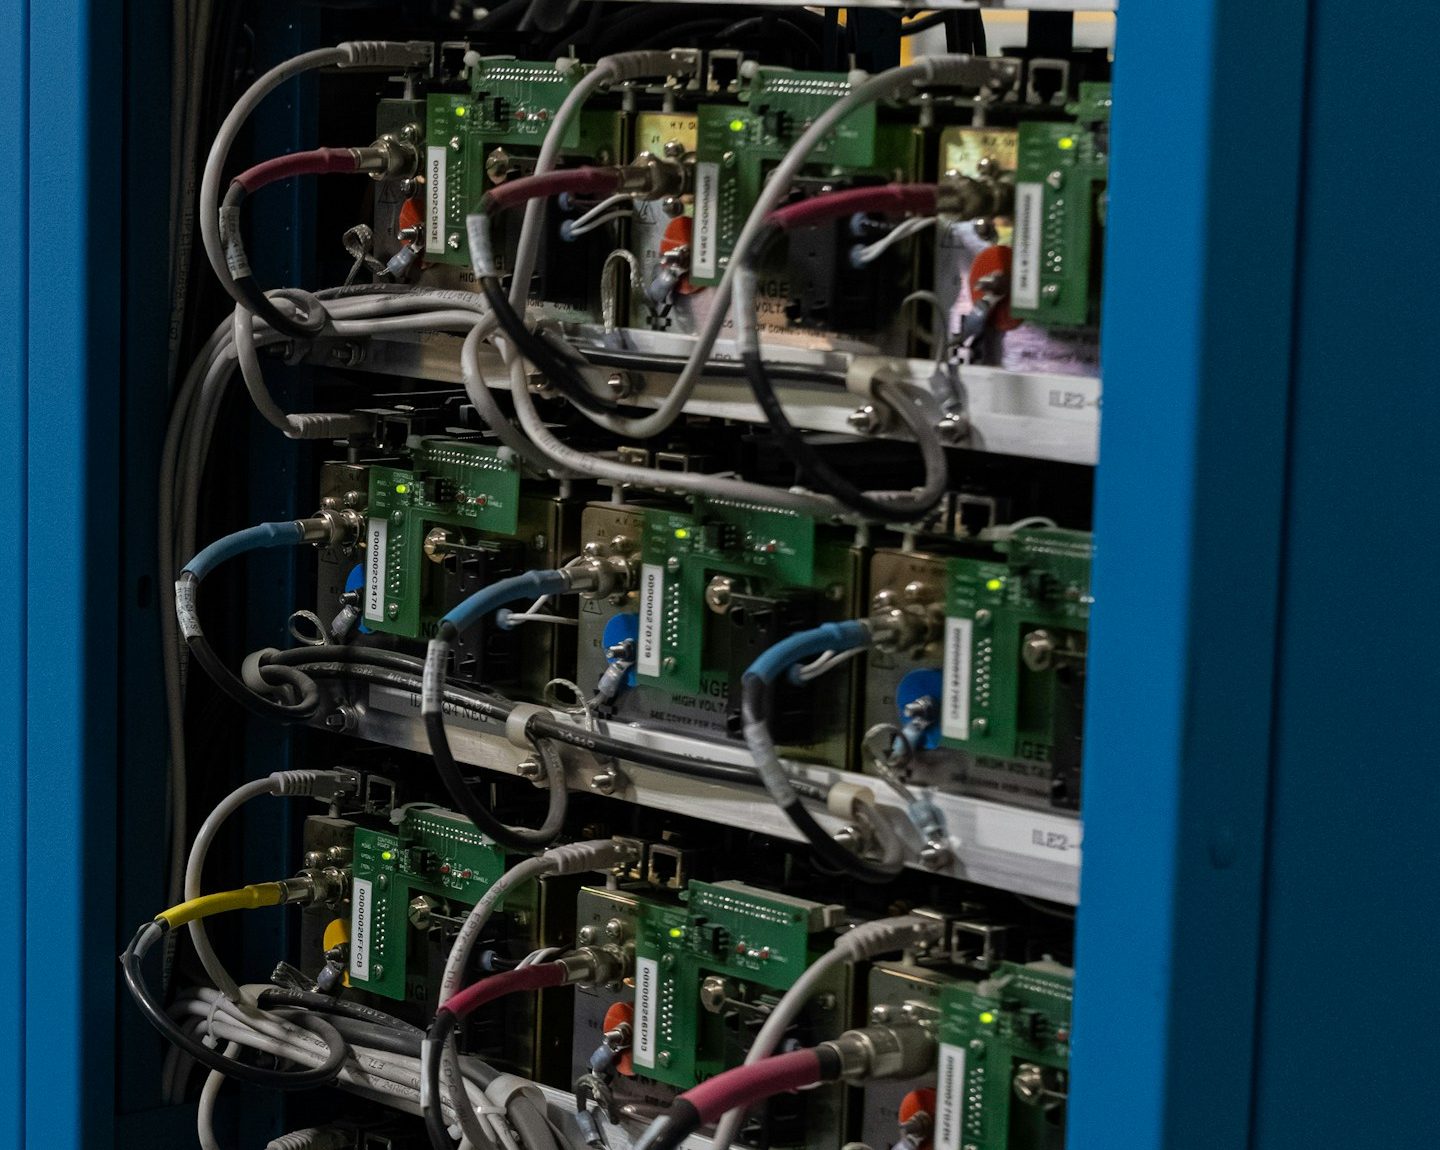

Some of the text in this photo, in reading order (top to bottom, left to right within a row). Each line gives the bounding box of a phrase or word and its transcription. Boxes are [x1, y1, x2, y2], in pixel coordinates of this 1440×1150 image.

[371, 531, 380, 610] 0000002C5470
[461, 706, 489, 724] NEG
[356, 888, 366, 968] 00000026FFCB
